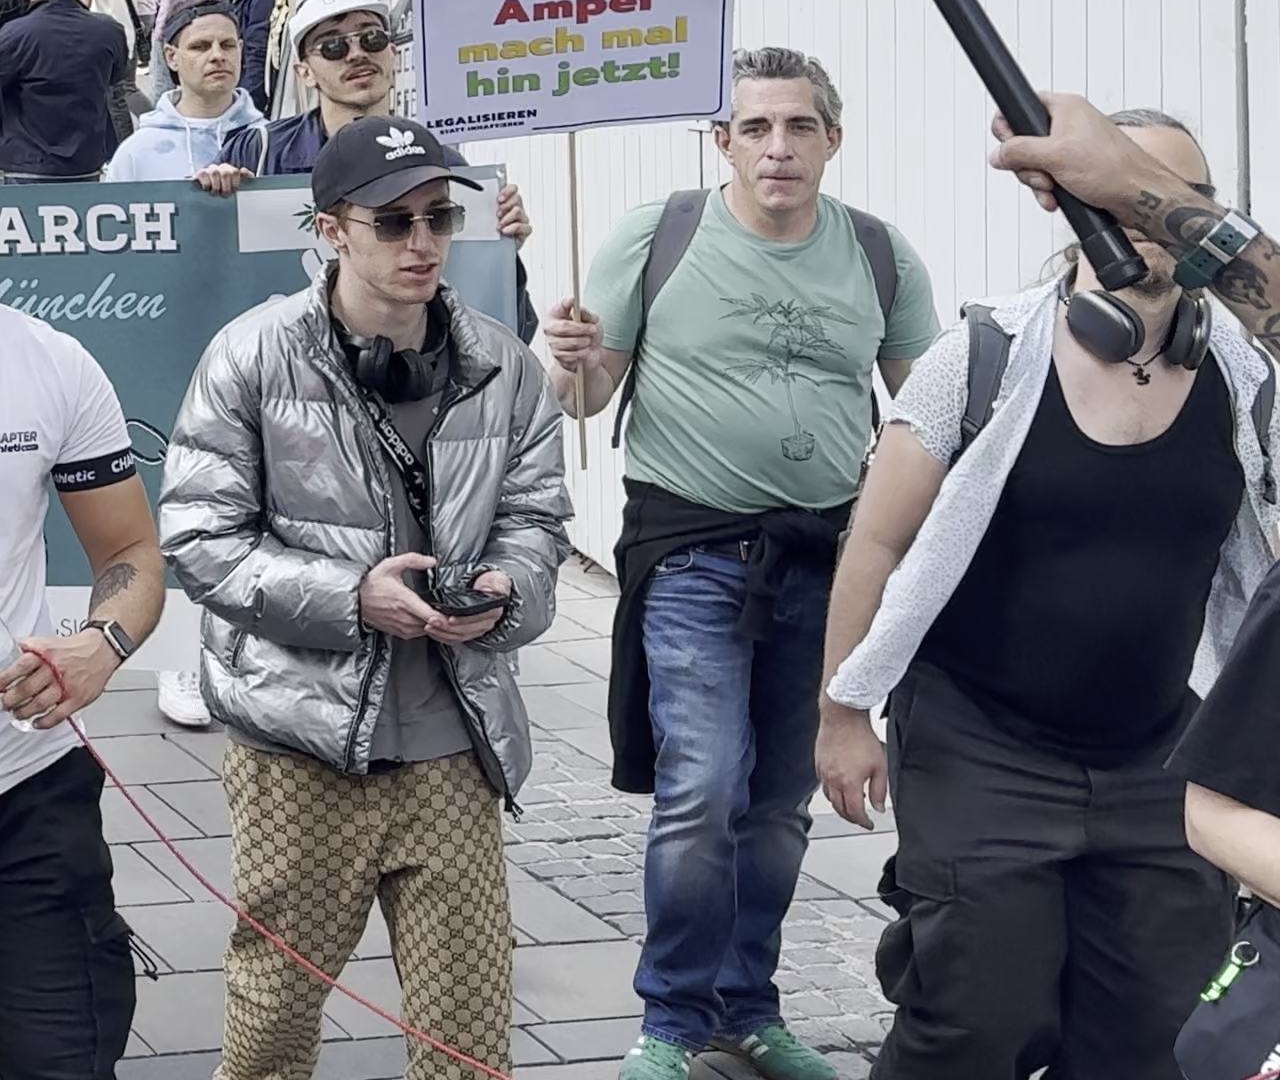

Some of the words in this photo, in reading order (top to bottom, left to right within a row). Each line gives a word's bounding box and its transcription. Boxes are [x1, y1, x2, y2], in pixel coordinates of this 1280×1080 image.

[458, 26, 585, 65] mach
[602, 15, 688, 50] mal
[466, 67, 542, 98] hin
[552, 52, 681, 97] jetzt!
[426, 108, 538, 129] LEGALISIEREN
[385, 145, 426, 161] adidas
[54, 469, 96, 485] thletic
